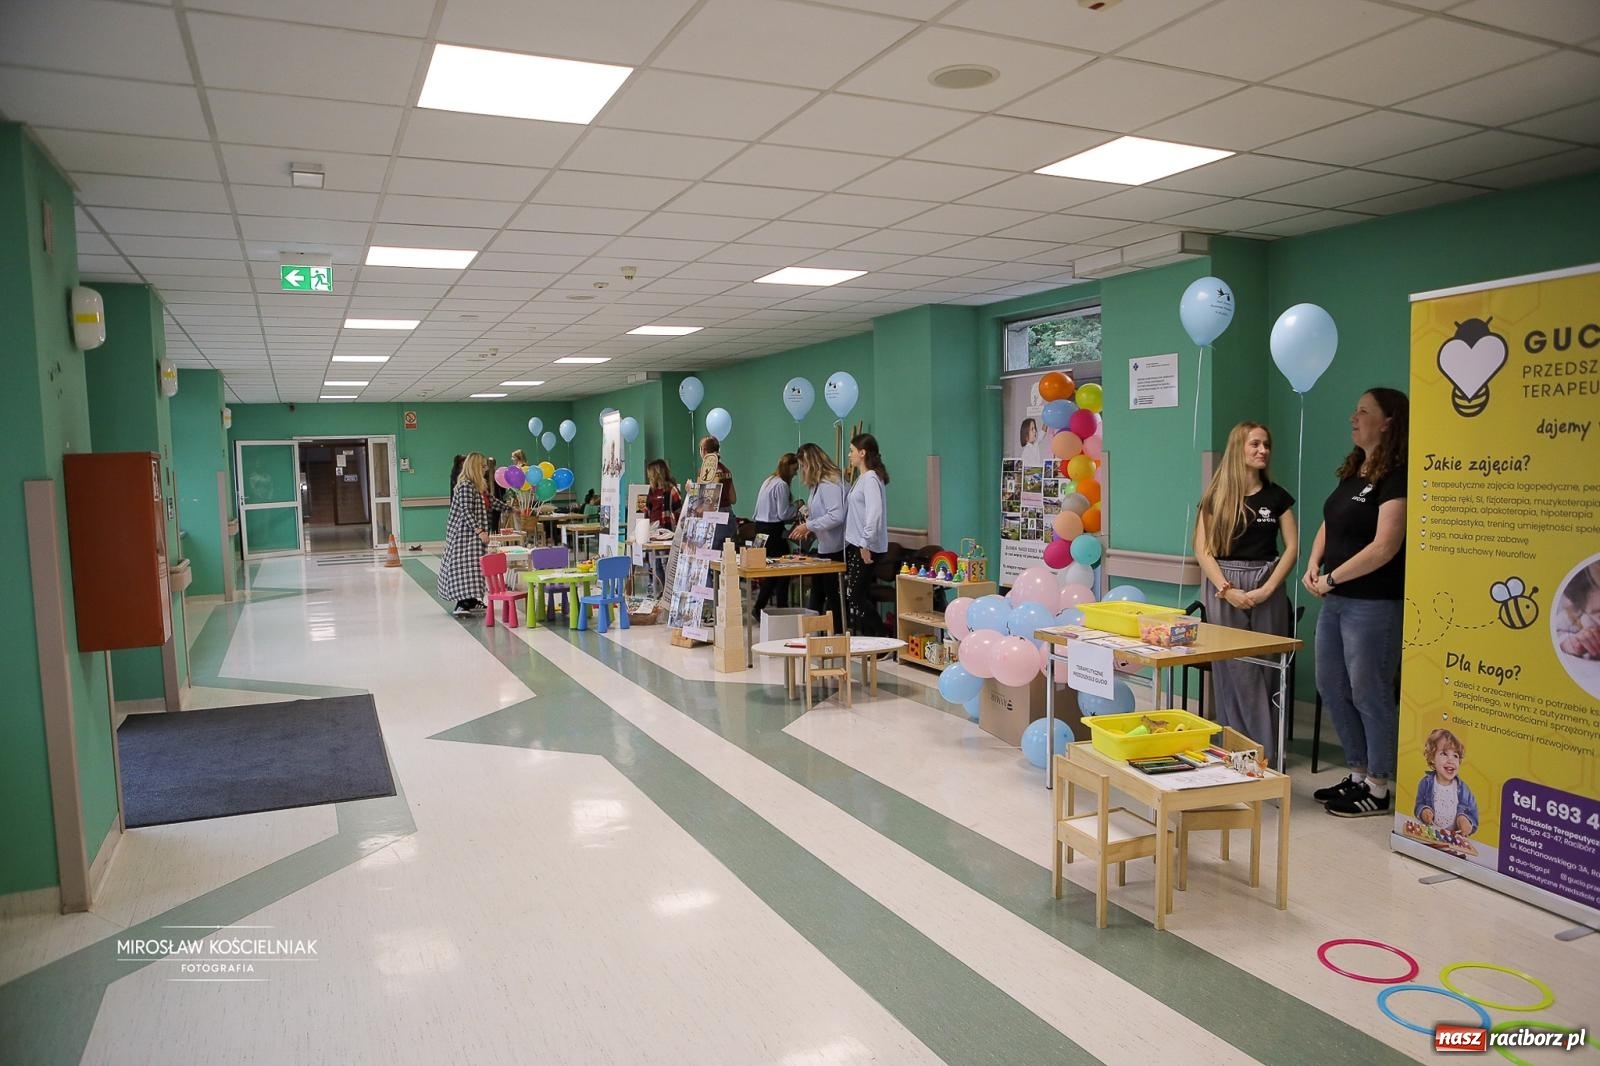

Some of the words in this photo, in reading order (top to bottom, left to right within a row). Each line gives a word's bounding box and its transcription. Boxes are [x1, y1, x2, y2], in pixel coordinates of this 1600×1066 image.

[1522, 359, 1598, 379] PRZEDSZ
[1536, 419, 1591, 442] dajemy
[1424, 454, 1462, 471] Jakie
[1468, 455, 1531, 477] zajęcia?
[1431, 481, 1485, 490] terapeutyczne
[1431, 494, 1457, 503] terapia
[1487, 520, 1516, 531] trening
[1517, 522, 1573, 533] umiejętności
[1448, 532, 1474, 541] nauka
[1475, 534, 1496, 543] przez
[1497, 535, 1530, 545] zabawę
[1429, 544, 1455, 554] trening
[1456, 547, 1494, 557] słuchowy
[1495, 549, 1537, 560] Neuroflow
[1446, 652, 1471, 672] Dla
[1478, 660, 1522, 686] kogo?
[1453, 679, 1475, 690] dzieci
[1481, 686, 1536, 703] orzeczeniami
[1452, 715, 1473, 727] dzieci
[1480, 722, 1534, 742] trudnościami
[1513, 790, 1541, 813] tel.
[1546, 800, 1582, 824] 693
[1586, 813, 1600, 830] 4
[1511, 812, 1553, 831] Przedszkole
[1538, 842, 1543, 850] 2
[1518, 844, 1577, 870] Kochanowskiego
